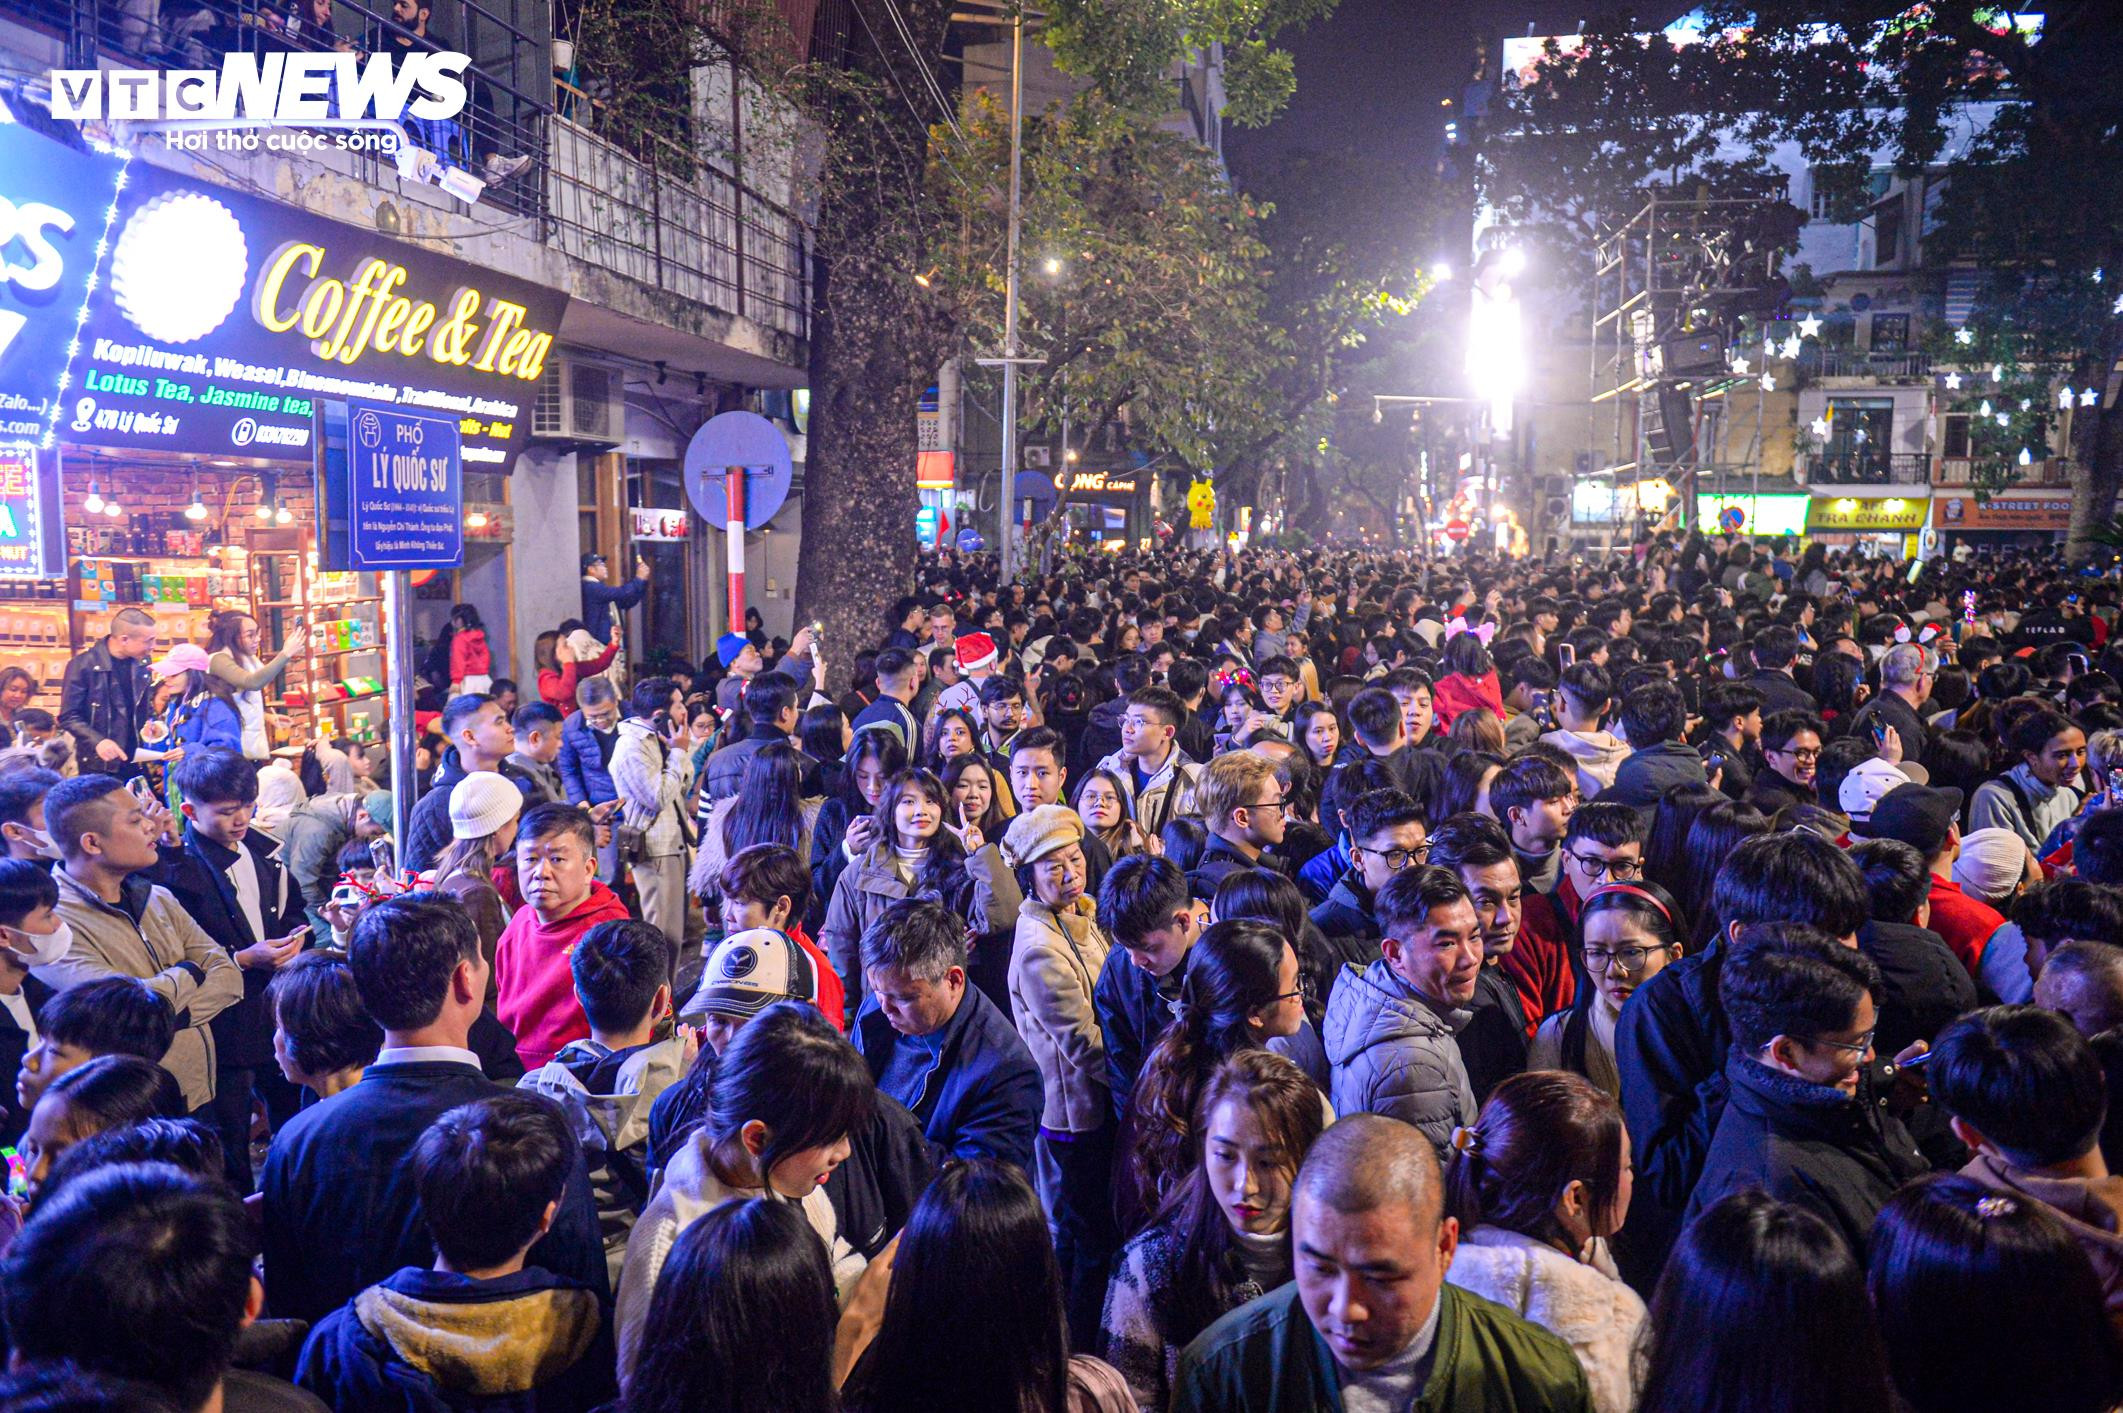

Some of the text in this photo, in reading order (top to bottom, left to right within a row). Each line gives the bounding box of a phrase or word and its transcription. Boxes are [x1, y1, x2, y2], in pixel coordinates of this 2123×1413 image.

[259, 242, 552, 381] Coffee & Tea
[85, 368, 313, 418] Lotus Tea, Jasmine tea,
[396, 419, 424, 445] PHỐ
[372, 446, 390, 489] LÝ
[393, 446, 428, 494] QUỐC
[430, 456, 448, 493] SƯ
